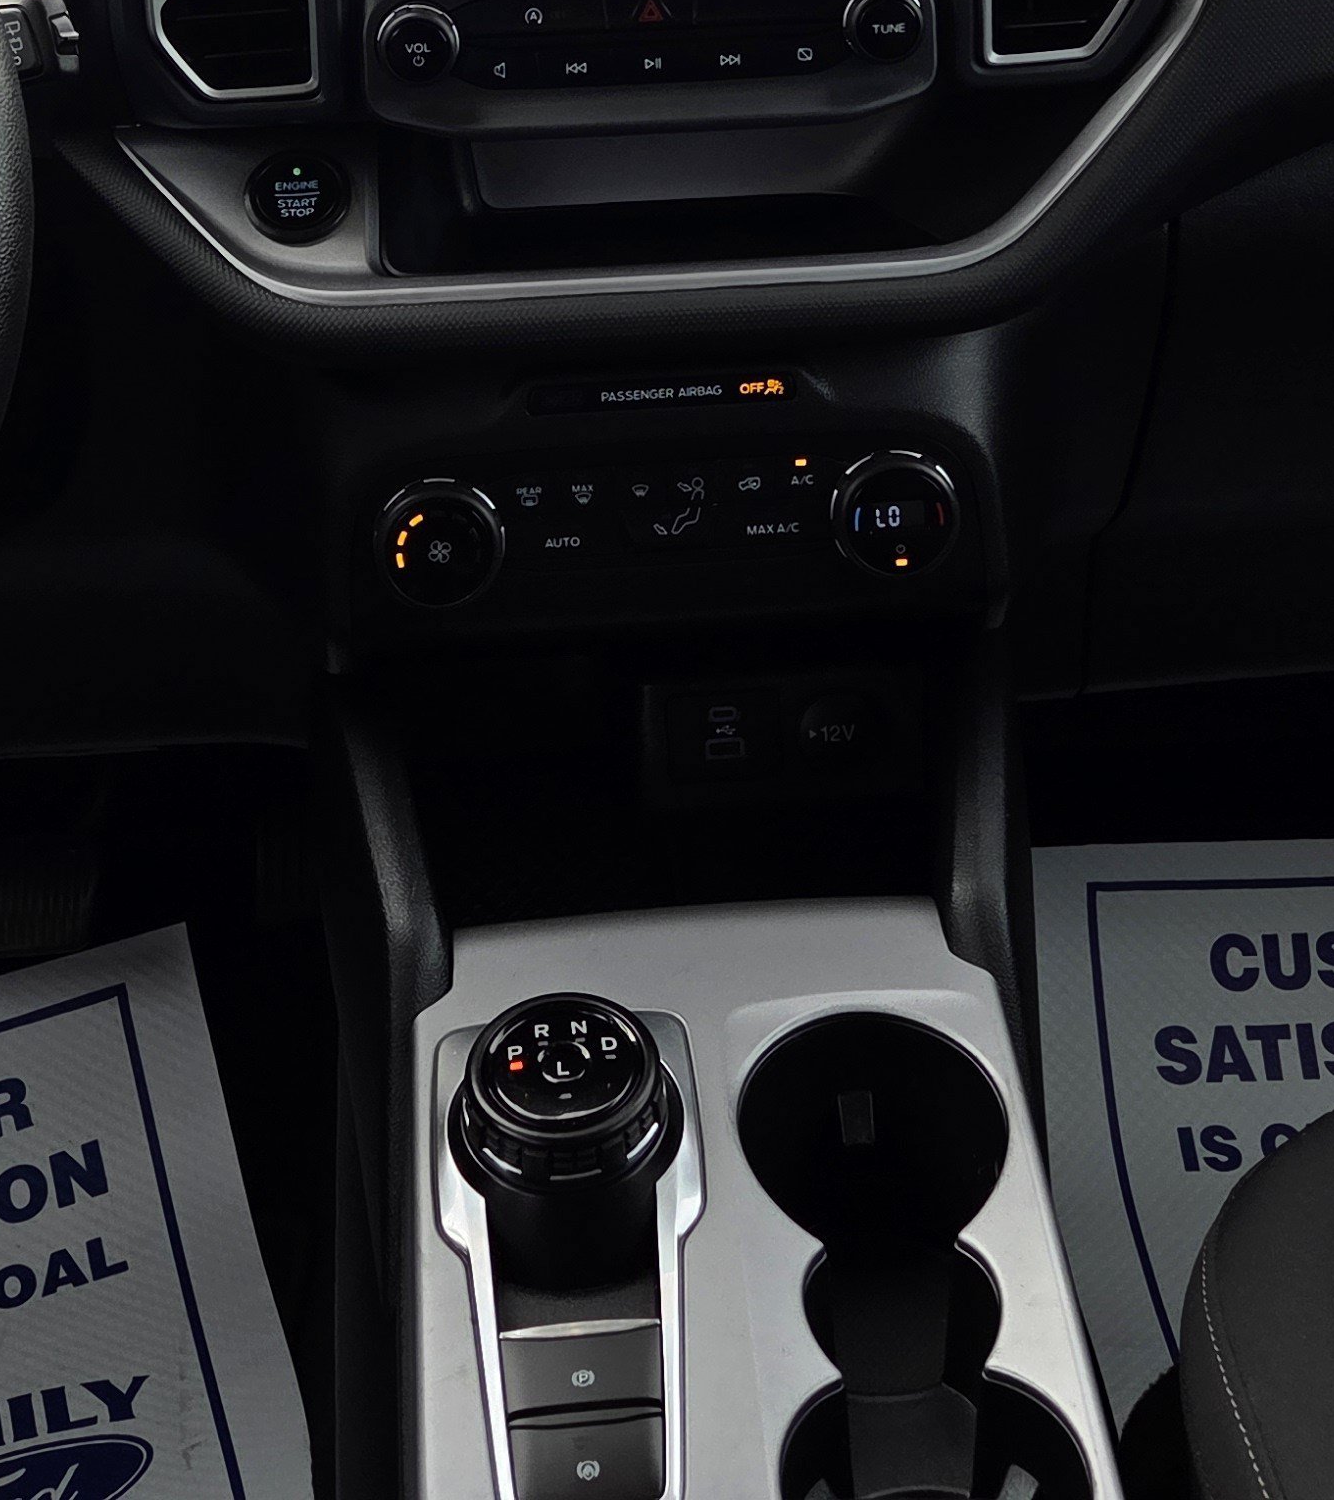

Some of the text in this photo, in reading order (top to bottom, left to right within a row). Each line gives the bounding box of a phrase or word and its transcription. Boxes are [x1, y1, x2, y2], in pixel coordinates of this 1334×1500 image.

[872, 22, 906, 34] TUNE
[404, 42, 432, 54] VOL
[274, 180, 319, 191] ENGINE
[277, 197, 318, 208] START
[280, 207, 315, 218] STOP
[600, 384, 723, 402] PASSENGER AIRBAG
[739, 382, 765, 395] OFF
[790, 474, 814, 486] A/C
[516, 486, 542, 496] REAR
[571, 484, 594, 492] MAX
[746, 522, 801, 536] MAX A/C
[544, 536, 581, 548] AUTO
[819, 723, 856, 742] 12V
[534, 1023, 550, 1038] R
[570, 1020, 587, 1035] N
[600, 1036, 618, 1051] D
[507, 1045, 523, 1060] P
[556, 1061, 570, 1076] L
[1176, 1124, 1243, 1172] IS
